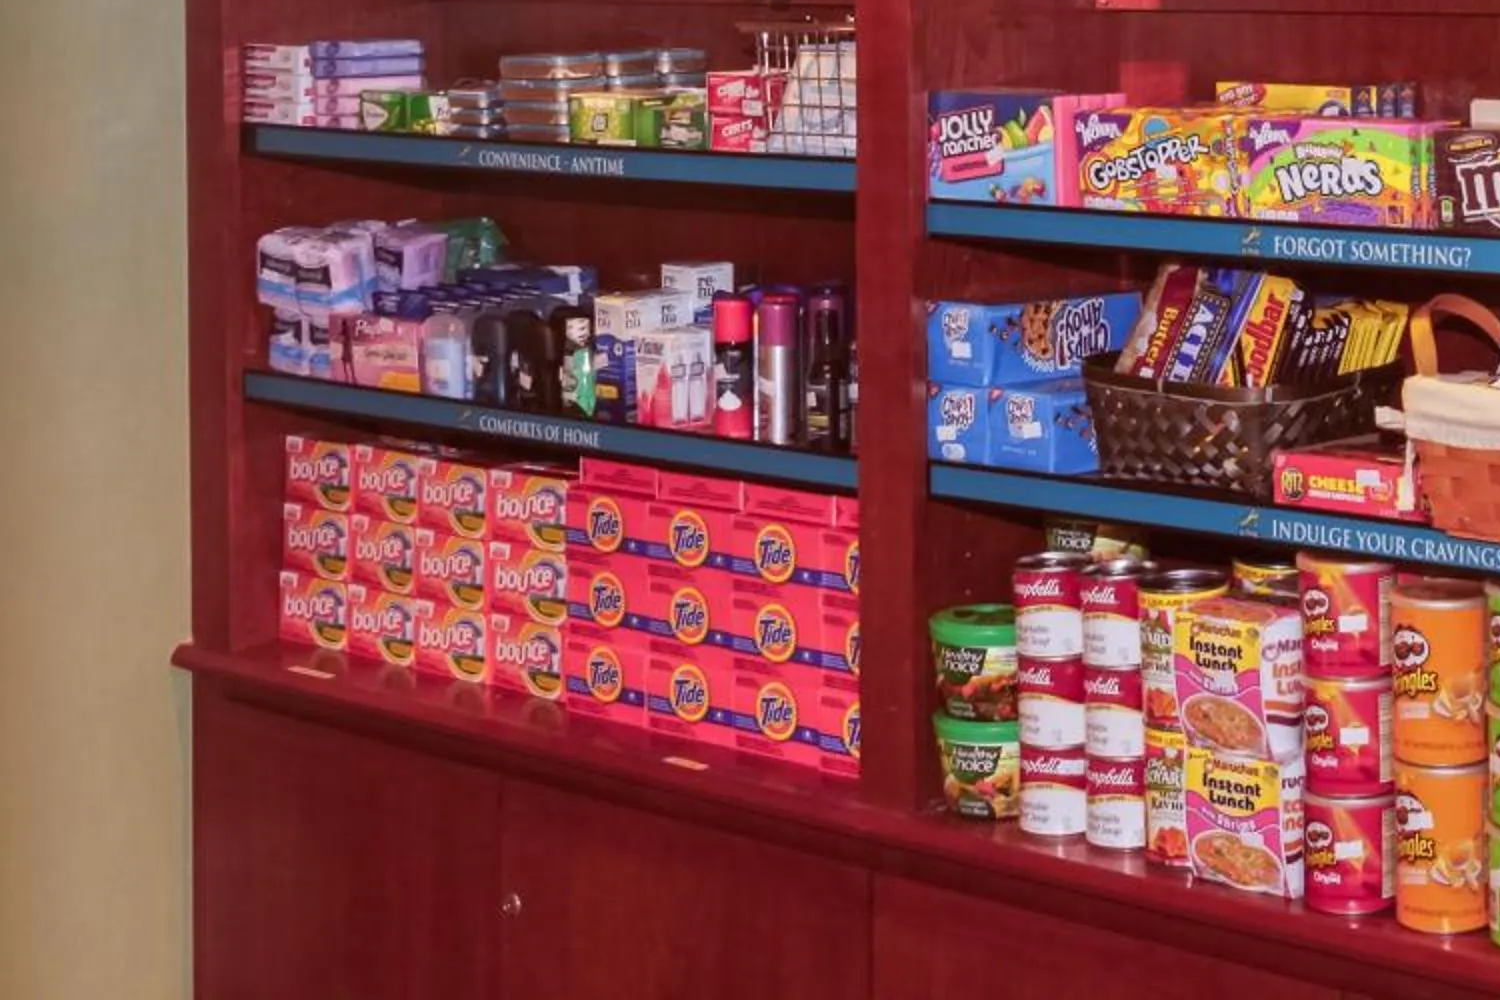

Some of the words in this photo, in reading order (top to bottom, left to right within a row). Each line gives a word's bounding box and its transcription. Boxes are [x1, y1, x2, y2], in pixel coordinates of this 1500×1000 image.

[937, 110, 994, 141] JOLLY
[942, 133, 998, 157] rancher
[478, 150, 562, 171] CONVENIENCE
[571, 158, 625, 176] ANYTIME
[1273, 235, 1348, 260] FORGOT
[1349, 240, 1472, 269] SOMETHING?
[1145, 306, 1179, 367] Butter
[1247, 292, 1285, 389] oodbar
[478, 415, 543, 440] COMFORTS
[544, 423, 561, 441] OF
[562, 426, 600, 447] HOME
[290, 453, 339, 481] bounce
[359, 470, 406, 493] bounce
[424, 480, 474, 507] bounce
[496, 493, 555, 520] bounce
[591, 510, 620, 537] Tide
[1272, 518, 1353, 549] INDULGE
[1355, 528, 1407, 556] YOUR
[288, 524, 338, 551] bounce
[355, 537, 403, 562] bounce
[673, 524, 706, 552] Tide
[420, 550, 472, 577] bounce
[758, 538, 791, 567] Tide
[494, 565, 552, 593] bounce
[283, 592, 336, 619] bounce
[593, 585, 622, 611] Tide
[353, 608, 403, 633] bounce
[674, 601, 705, 630] Tide
[419, 622, 473, 649] bounce
[758, 619, 792, 647] Tide
[496, 637, 548, 665] bounce
[1189, 636, 1243, 660] Instant
[591, 660, 620, 687] Tide
[1195, 653, 1238, 674] Lunch
[673, 678, 706, 706] Tide
[760, 697, 793, 725] Tide
[1202, 772, 1262, 798] Instant
[1209, 791, 1256, 811] Lunch
